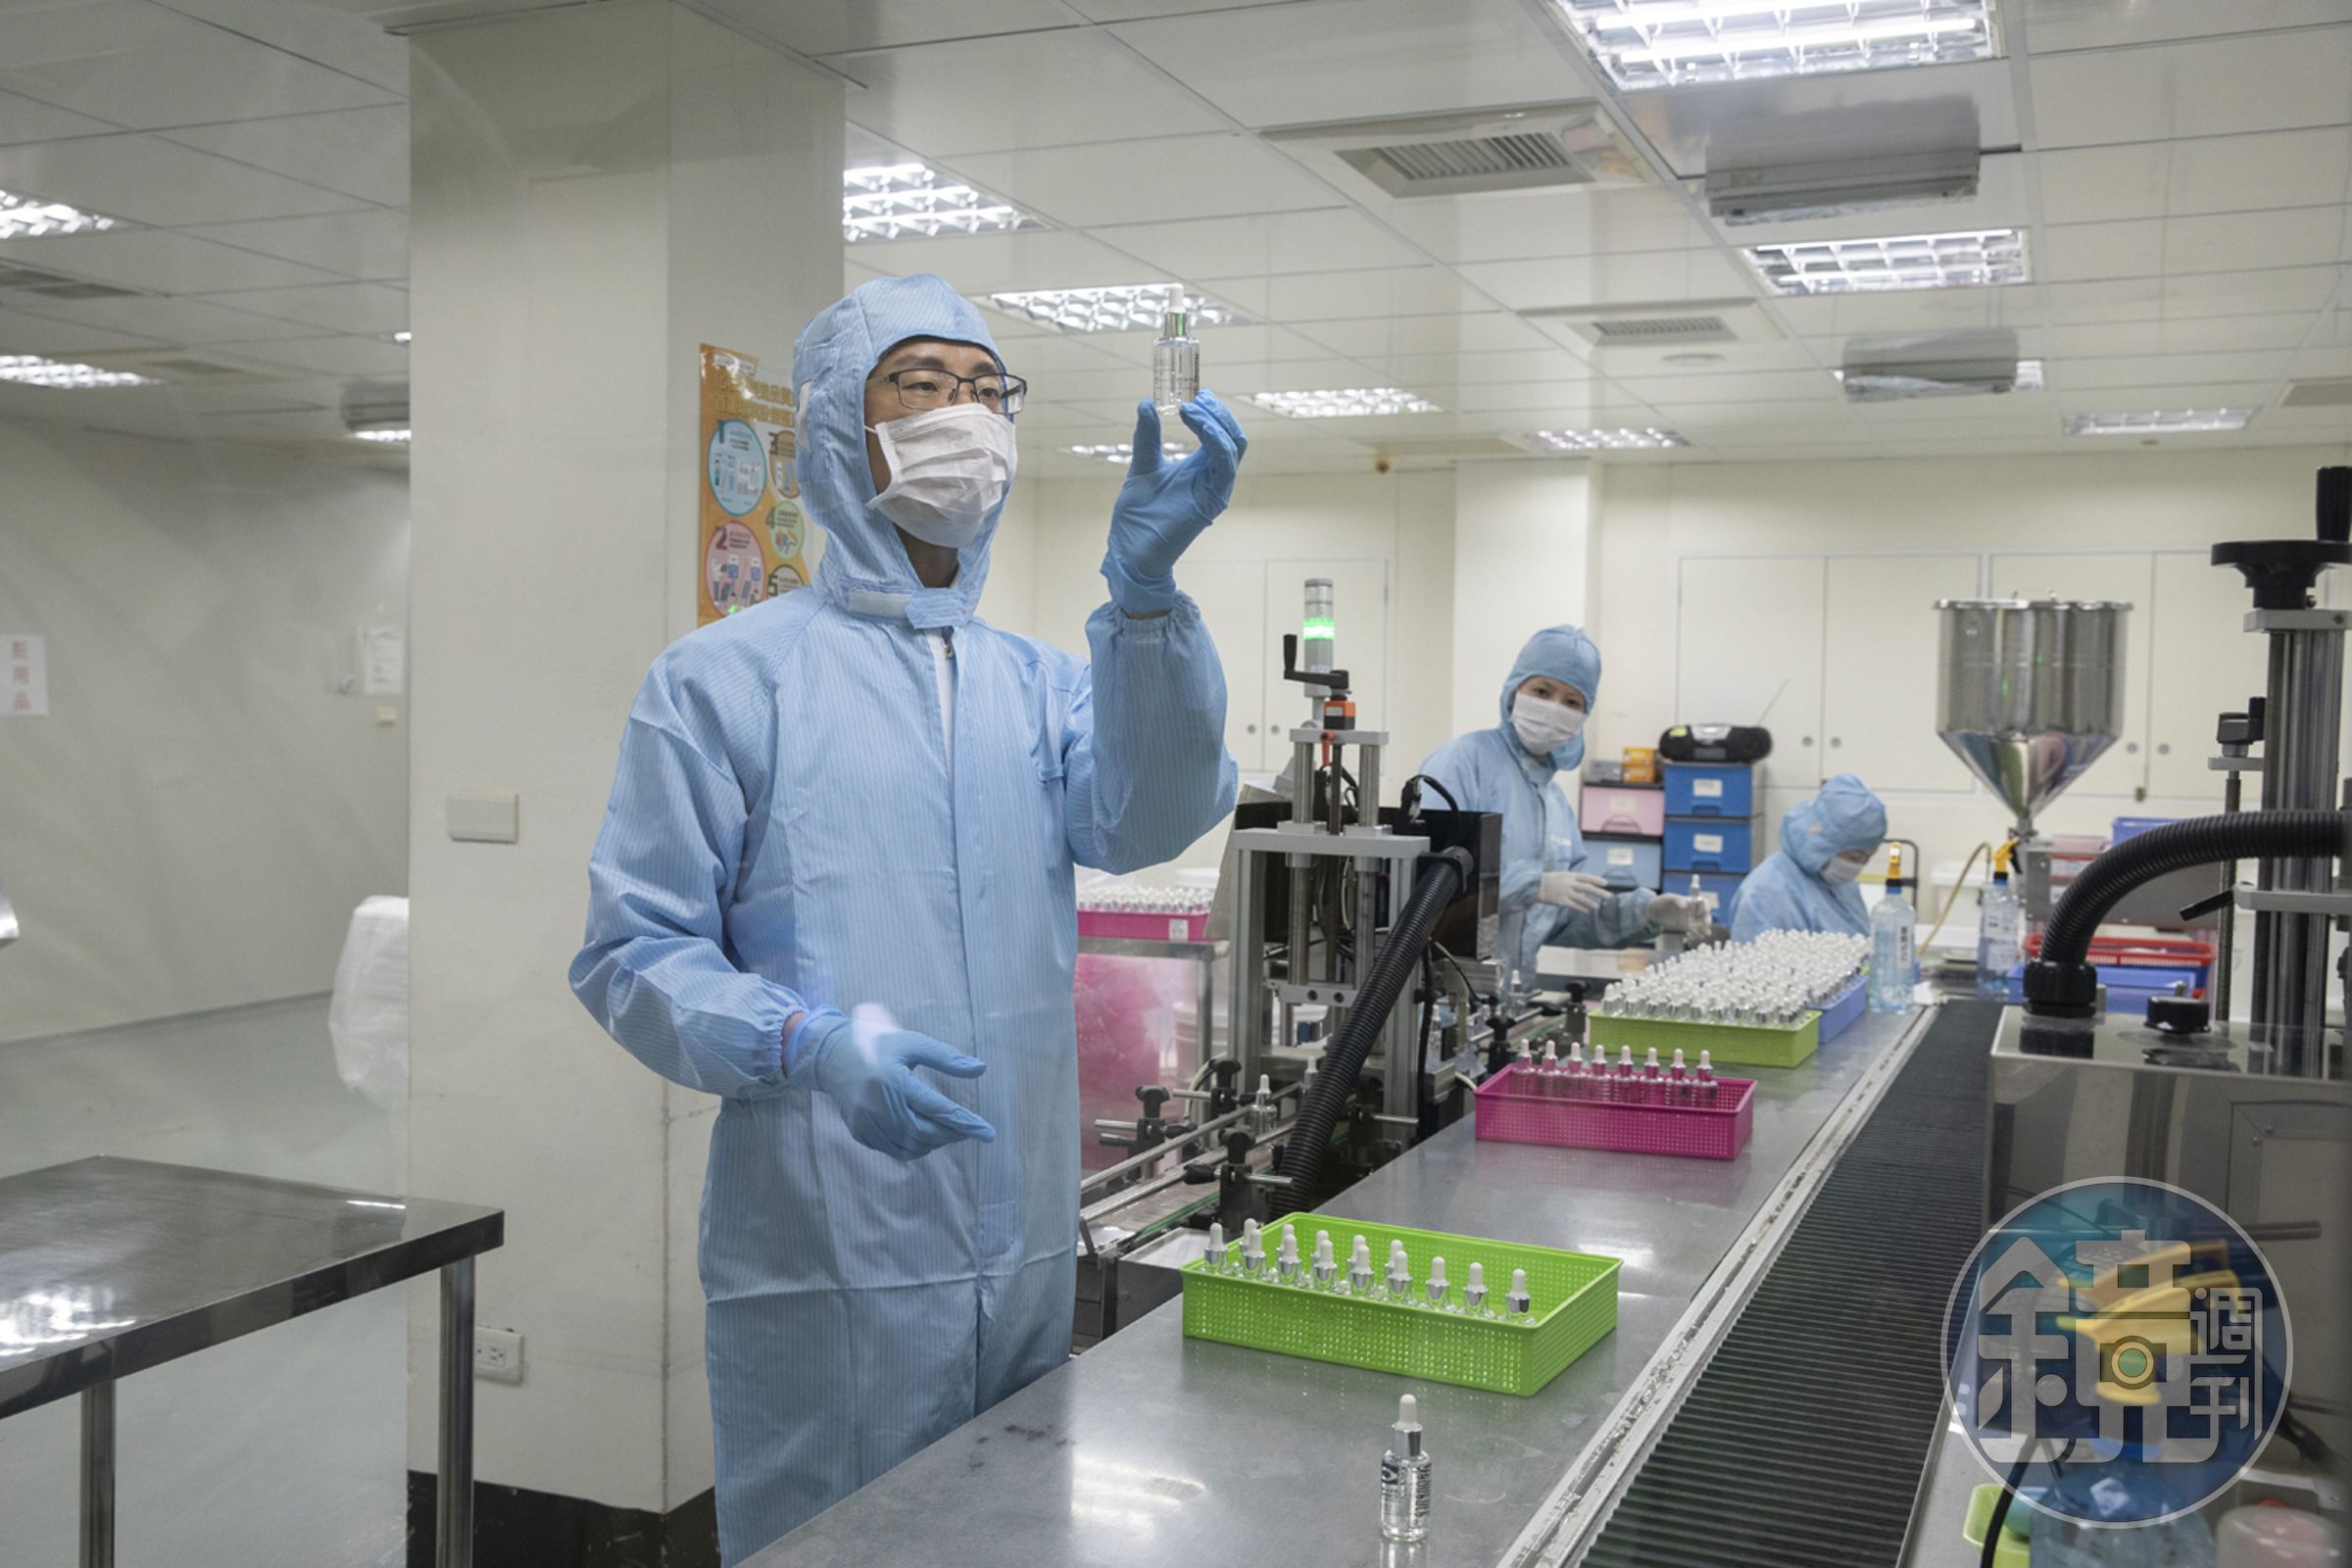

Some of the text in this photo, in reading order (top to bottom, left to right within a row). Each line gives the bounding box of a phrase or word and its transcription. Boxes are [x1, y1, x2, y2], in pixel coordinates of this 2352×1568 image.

[717, 419, 725, 443] 1
[765, 507, 776, 529] 4
[715, 525, 728, 550] 2
[768, 574, 778, 597] 5
